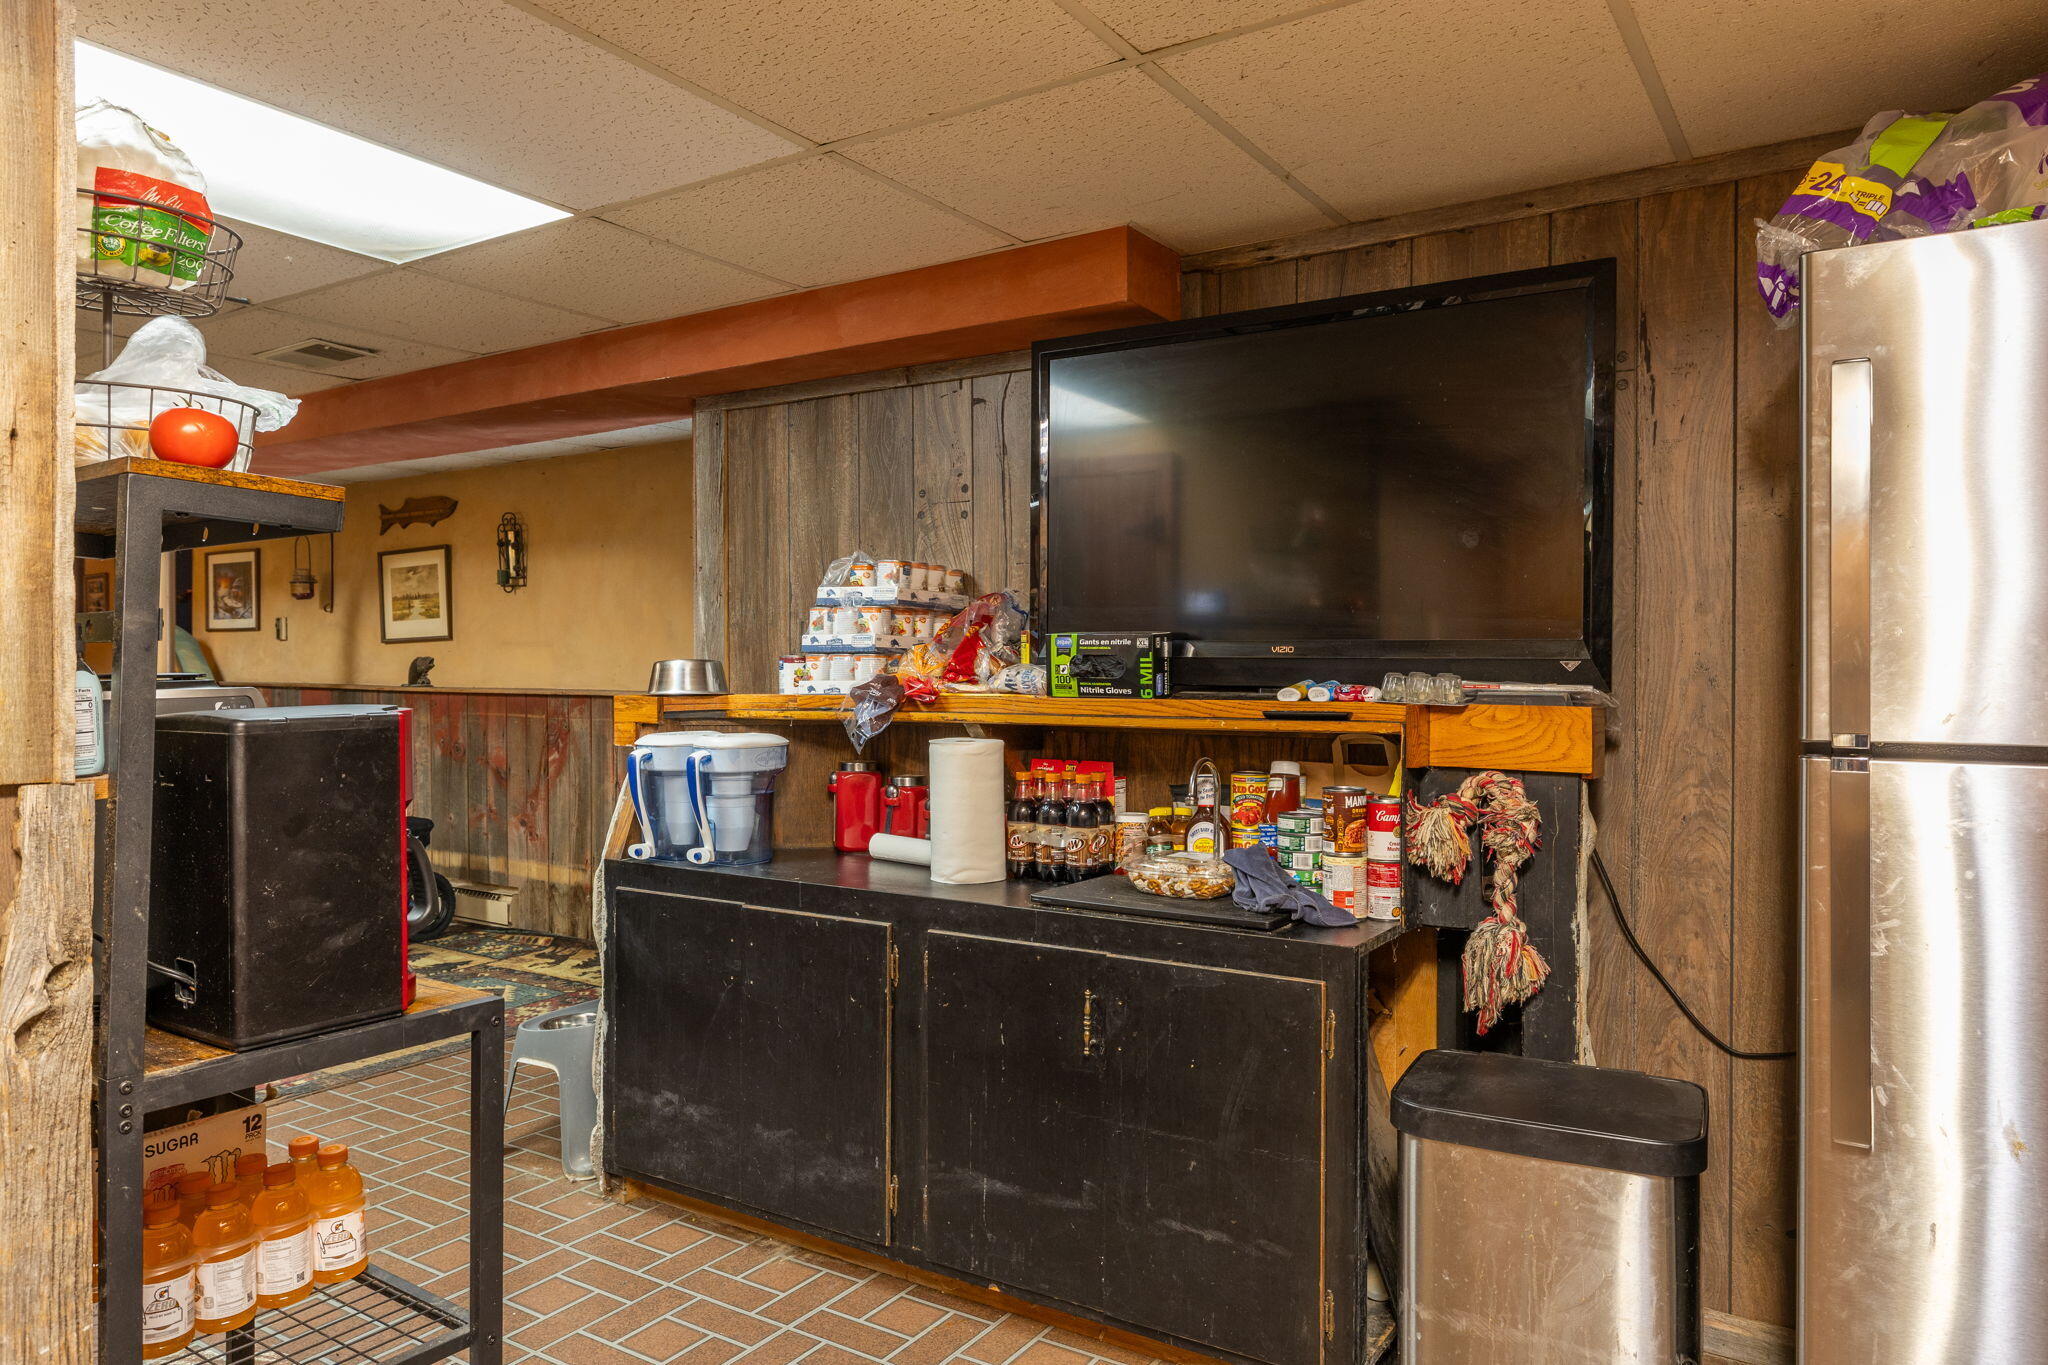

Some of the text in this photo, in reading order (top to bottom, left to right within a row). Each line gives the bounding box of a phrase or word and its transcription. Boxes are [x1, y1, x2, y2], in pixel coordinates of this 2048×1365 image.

[1856, 190, 1885, 200] TRIPLE
[104, 214, 163, 237] Coffee
[1055, 676, 1071, 684] 100
[1139, 651, 1153, 699] 6 MIL
[1080, 686, 1105, 694] Nitrile
[1105, 687, 1132, 695] Gloves
[1232, 783, 1247, 793] RED
[242, 1113, 263, 1134] 12
[245, 1130, 261, 1140] PACK
[144, 1132, 199, 1158] SUGAR
[148, 1299, 176, 1312] ZERO
